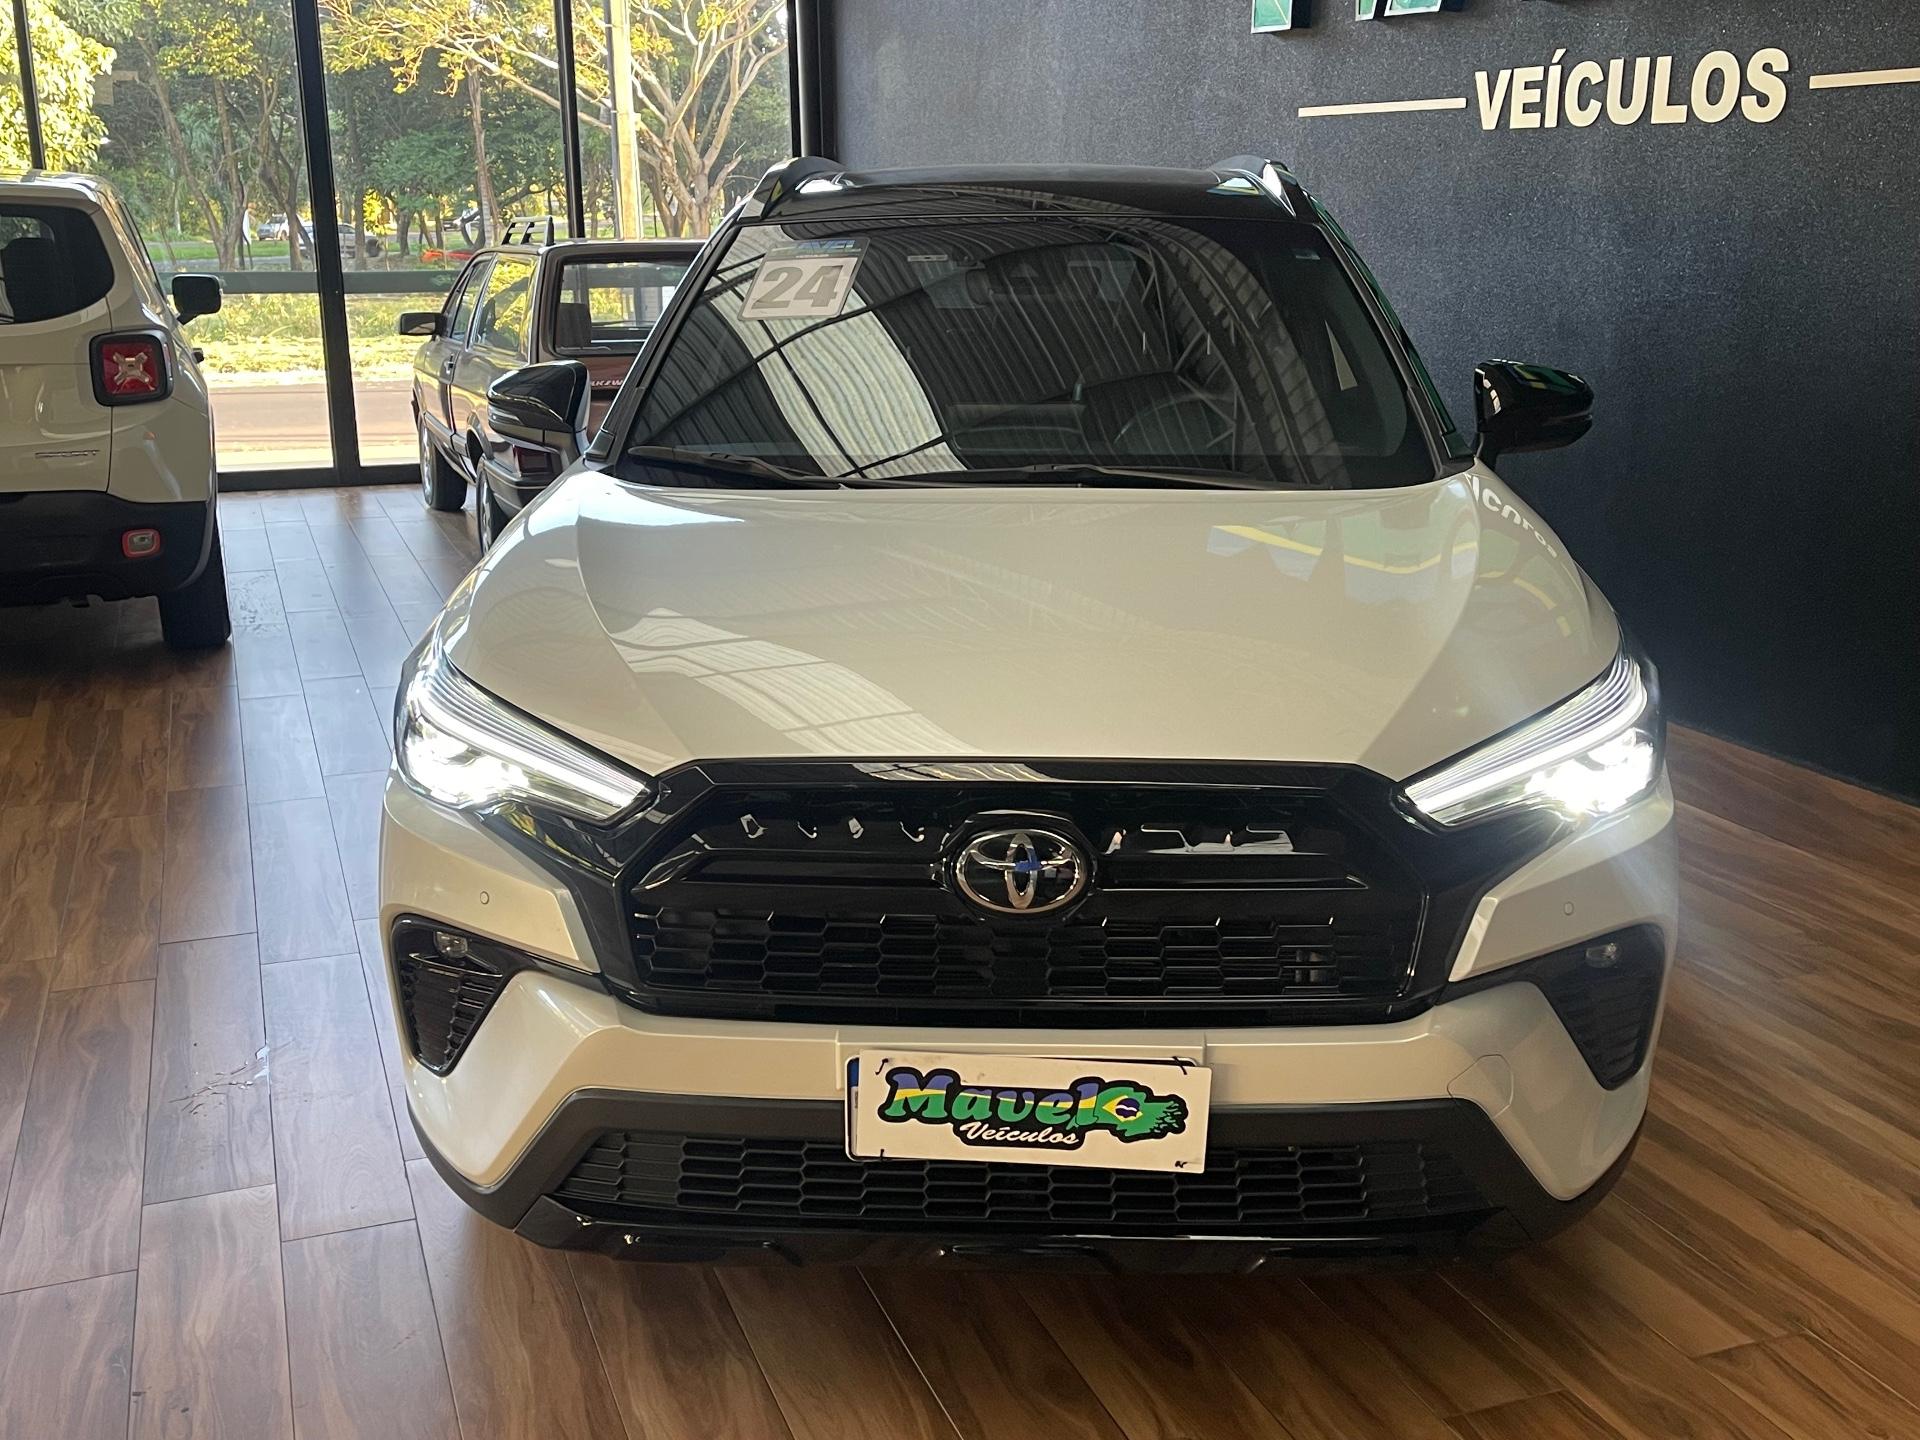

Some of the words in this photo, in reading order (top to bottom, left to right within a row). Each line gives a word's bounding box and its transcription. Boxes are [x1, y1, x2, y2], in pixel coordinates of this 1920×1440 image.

[1474, 48, 1790, 131] VEÍCULOS
[750, 265, 844, 309] 24
[883, 1072, 1100, 1127] Mavel
